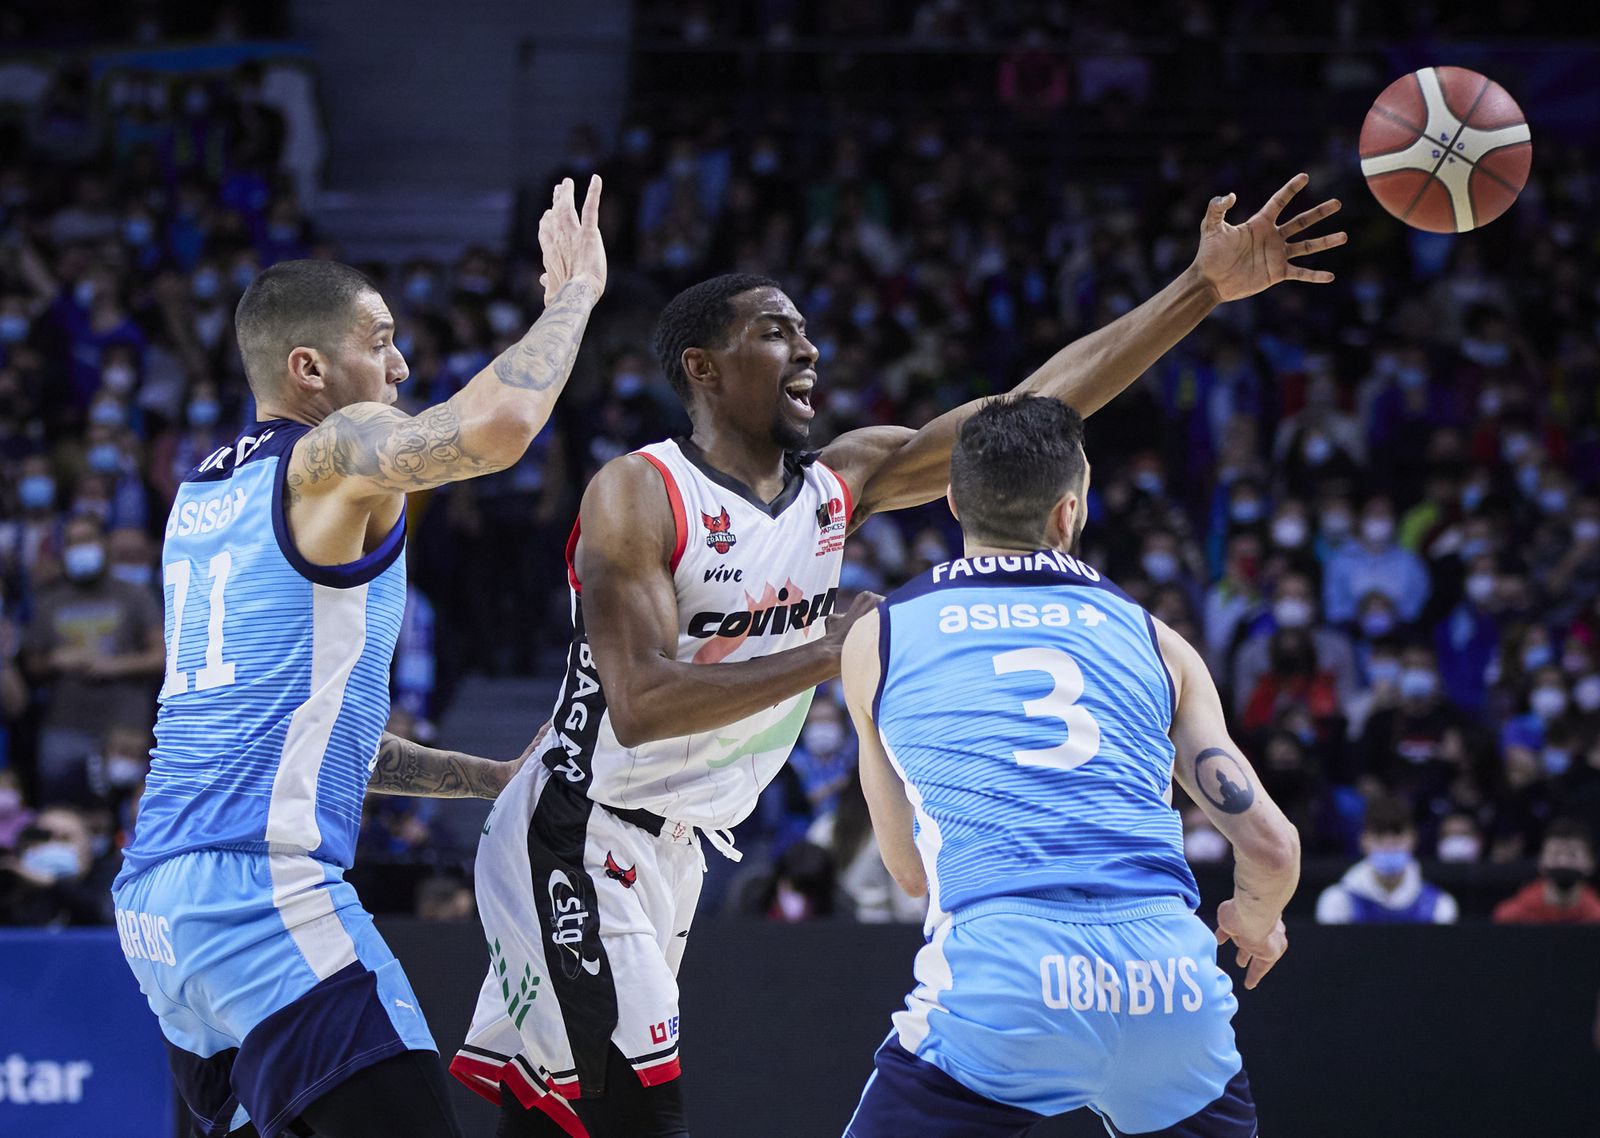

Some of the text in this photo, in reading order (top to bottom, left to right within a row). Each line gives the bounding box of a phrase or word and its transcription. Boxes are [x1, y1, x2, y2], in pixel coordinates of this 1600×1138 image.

[932, 550, 1101, 583] FAGGIANO
[157, 551, 236, 700] 11
[938, 603, 1071, 634] asisa
[554, 642, 600, 782] BAGAR
[992, 647, 1100, 770] 3
[115, 908, 176, 967] ORBYS
[552, 897, 589, 944] stg
[1039, 954, 1203, 1015] DORBYS
[0, 1053, 93, 1104] tar
